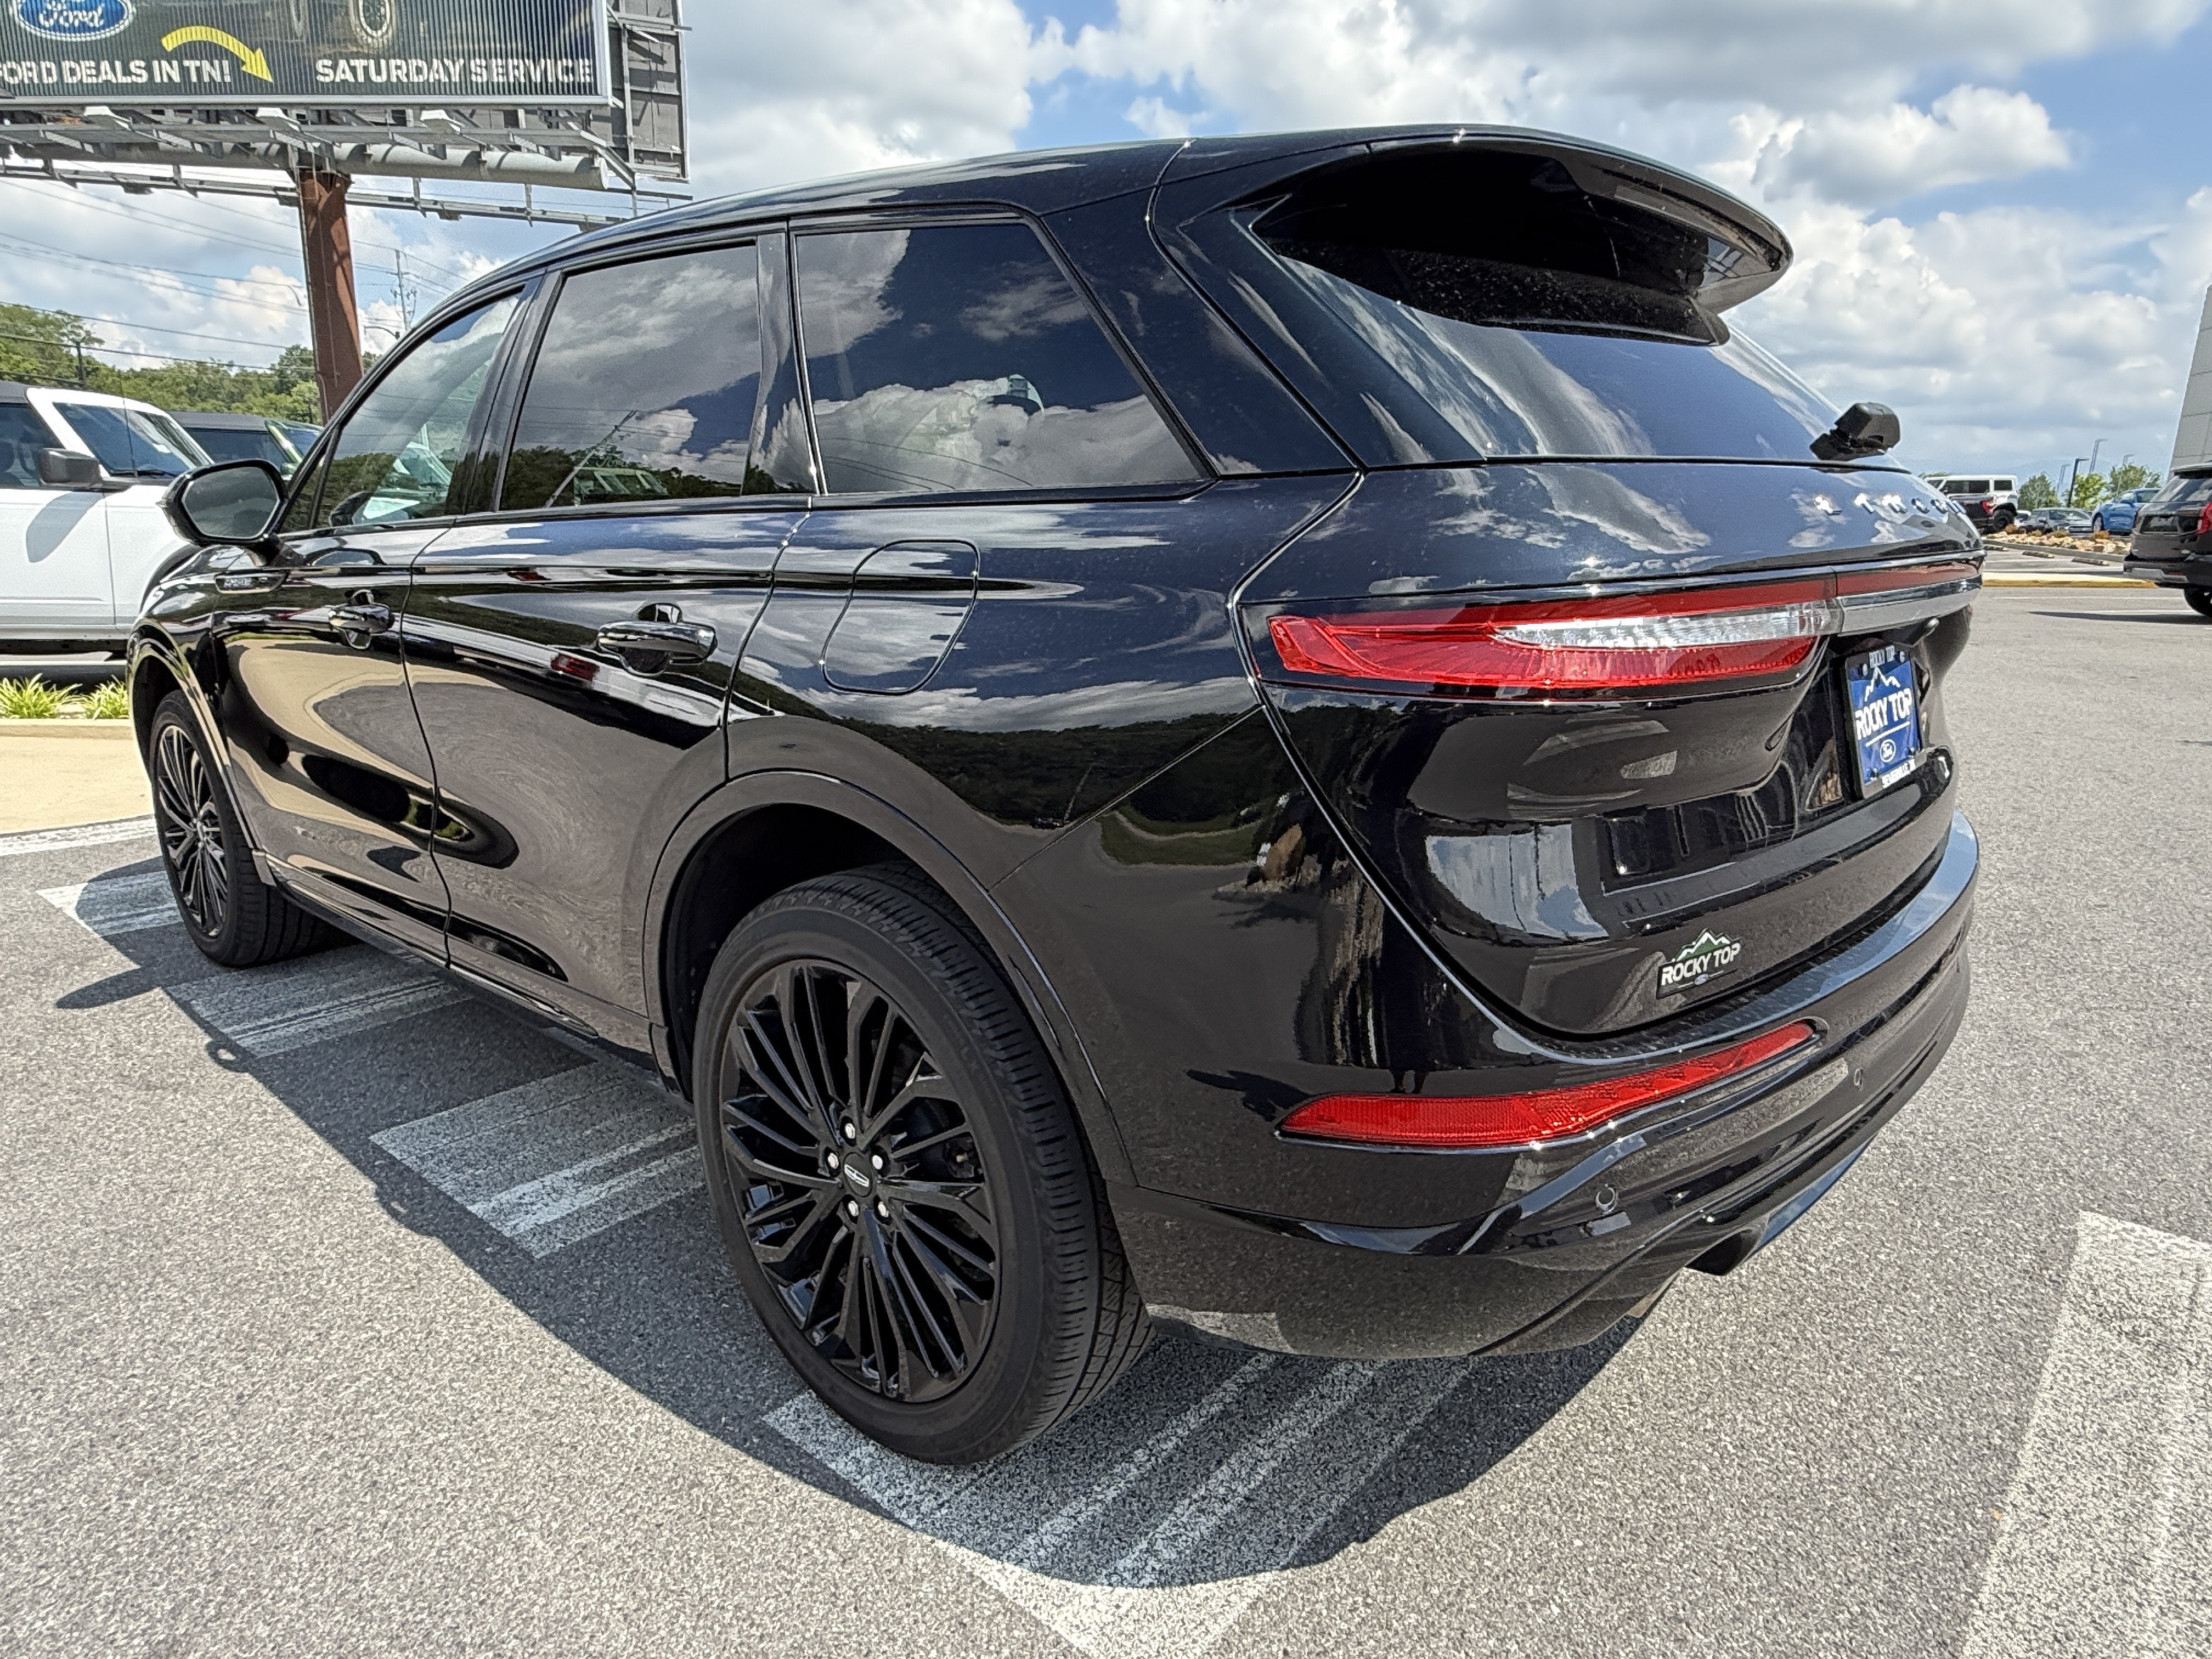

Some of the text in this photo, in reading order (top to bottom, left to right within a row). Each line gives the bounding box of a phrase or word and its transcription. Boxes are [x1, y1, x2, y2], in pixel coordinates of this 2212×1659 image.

[0, 60, 57, 84] ORD
[61, 60, 148, 84] DEALS
[153, 59, 181, 83] IN
[315, 58, 594, 83] SATURDAY SERVICE
[1855, 688, 1912, 741] ROCKY TOP
[1661, 943, 1741, 986] ROCKY TOP
